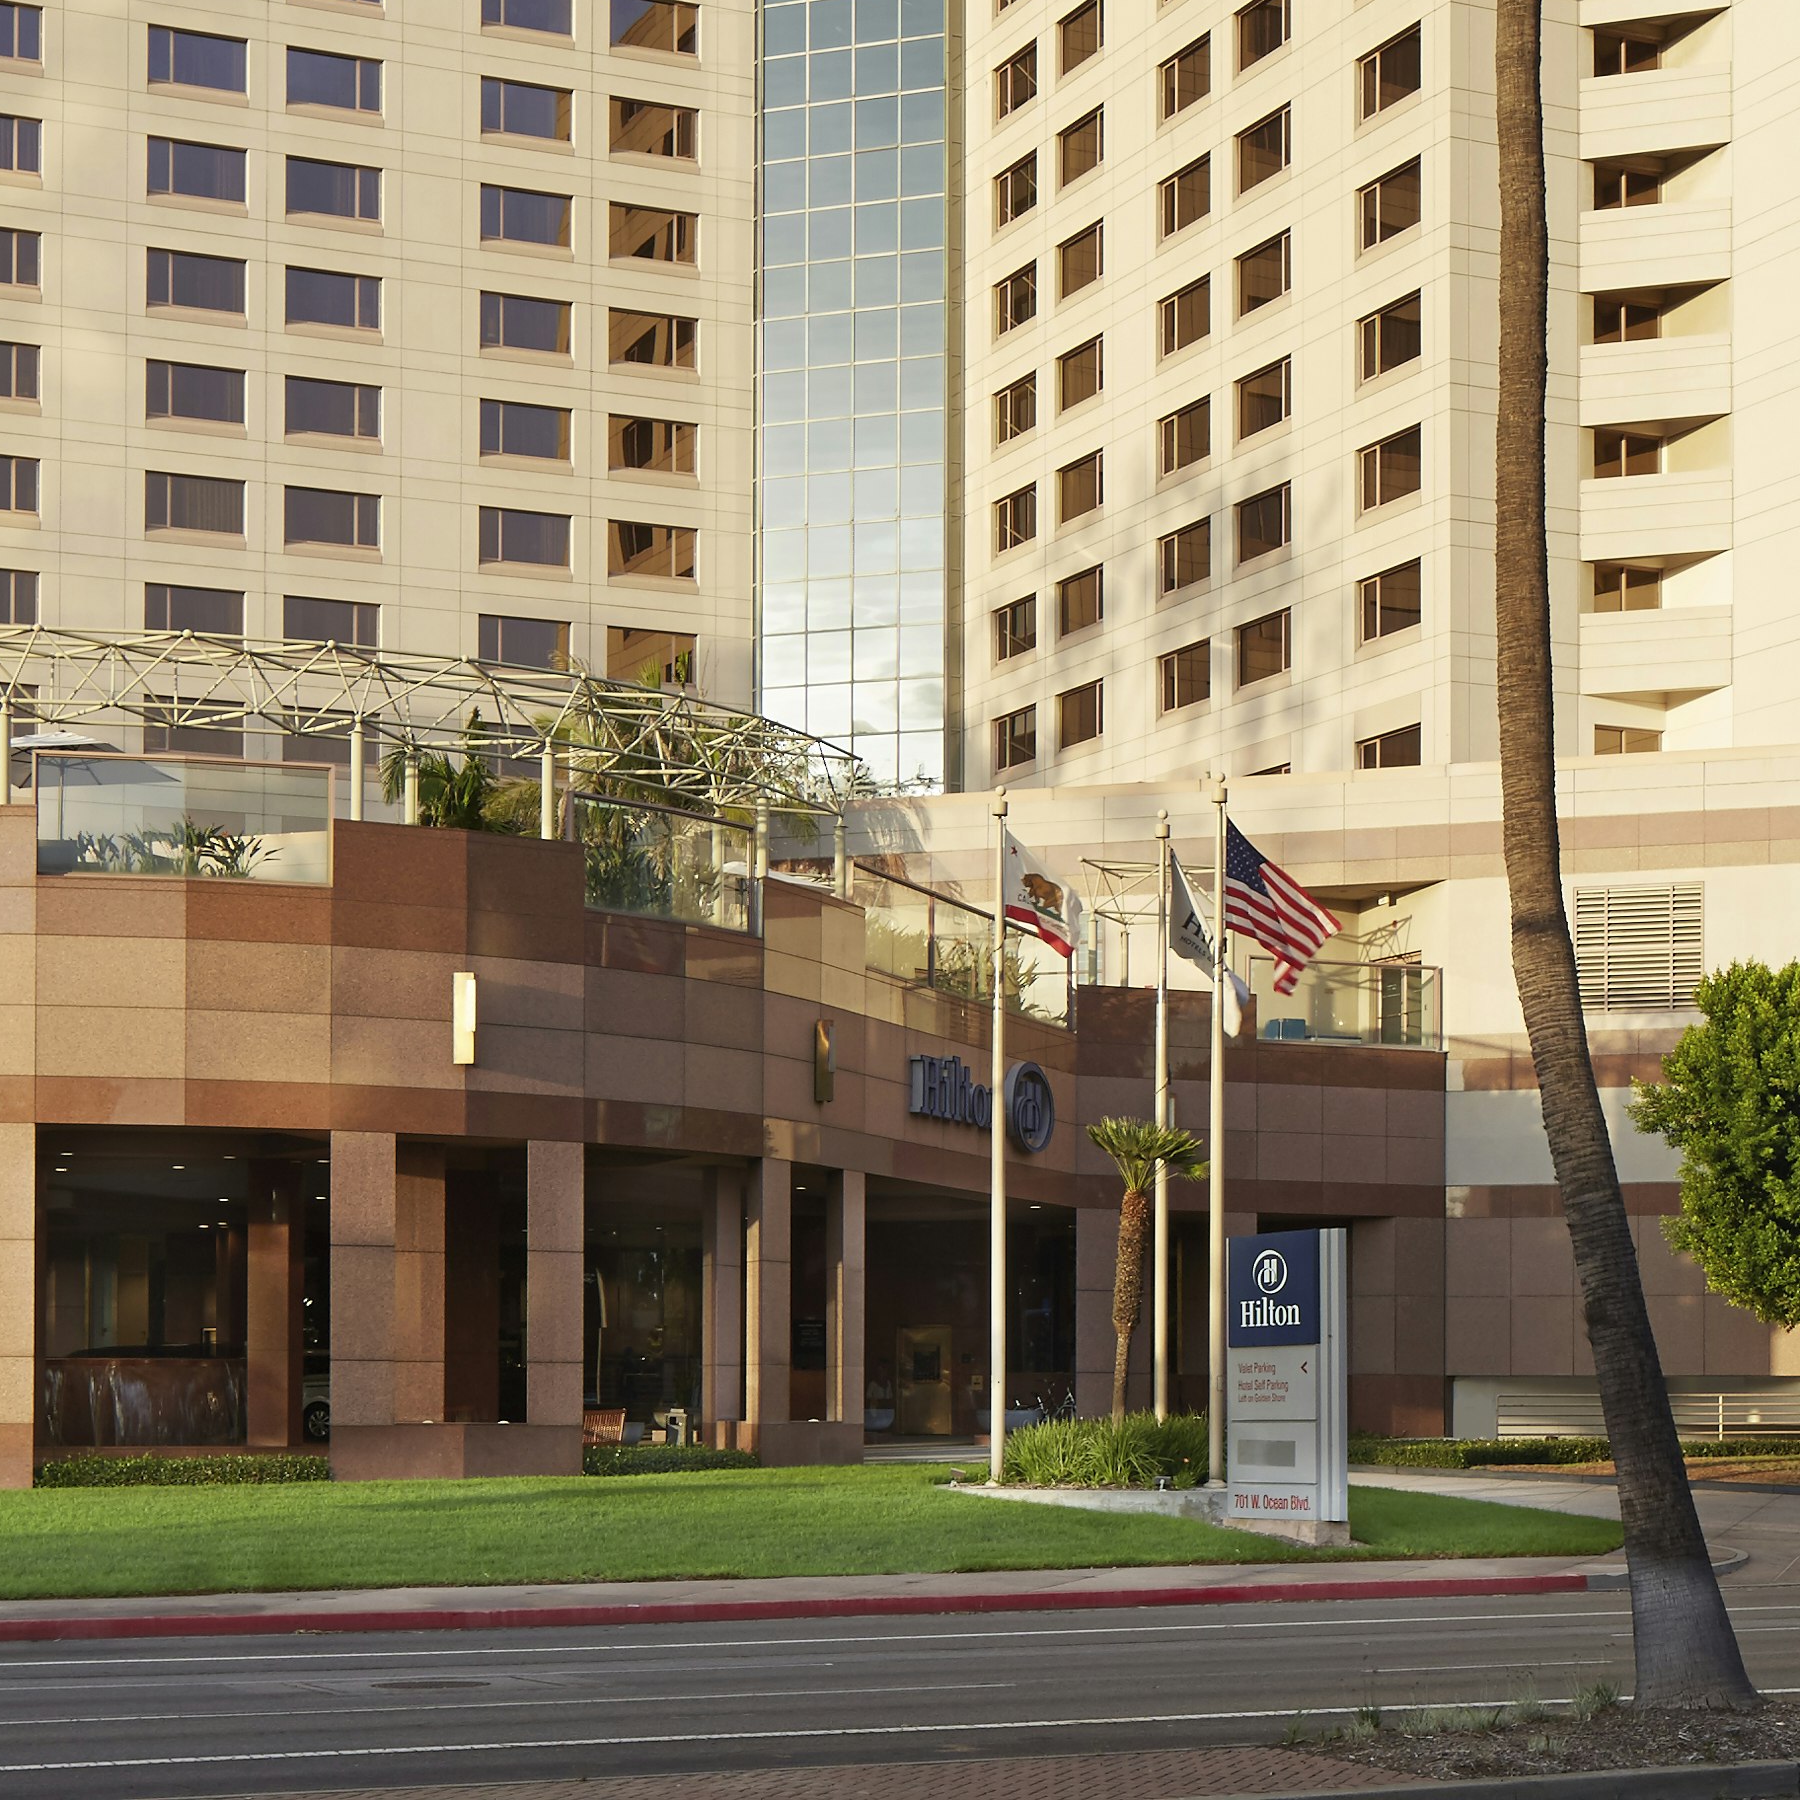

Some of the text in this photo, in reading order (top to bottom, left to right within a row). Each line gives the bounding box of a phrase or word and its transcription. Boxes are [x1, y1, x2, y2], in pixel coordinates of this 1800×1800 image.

[1240, 1297, 1301, 1327] Hilton
[1238, 1362, 1276, 1376] Valet Parking
[1238, 1379, 1289, 1393] Hotel Self Parking
[1234, 1494, 1312, 1511] 701 W. Ocean Blvd.
